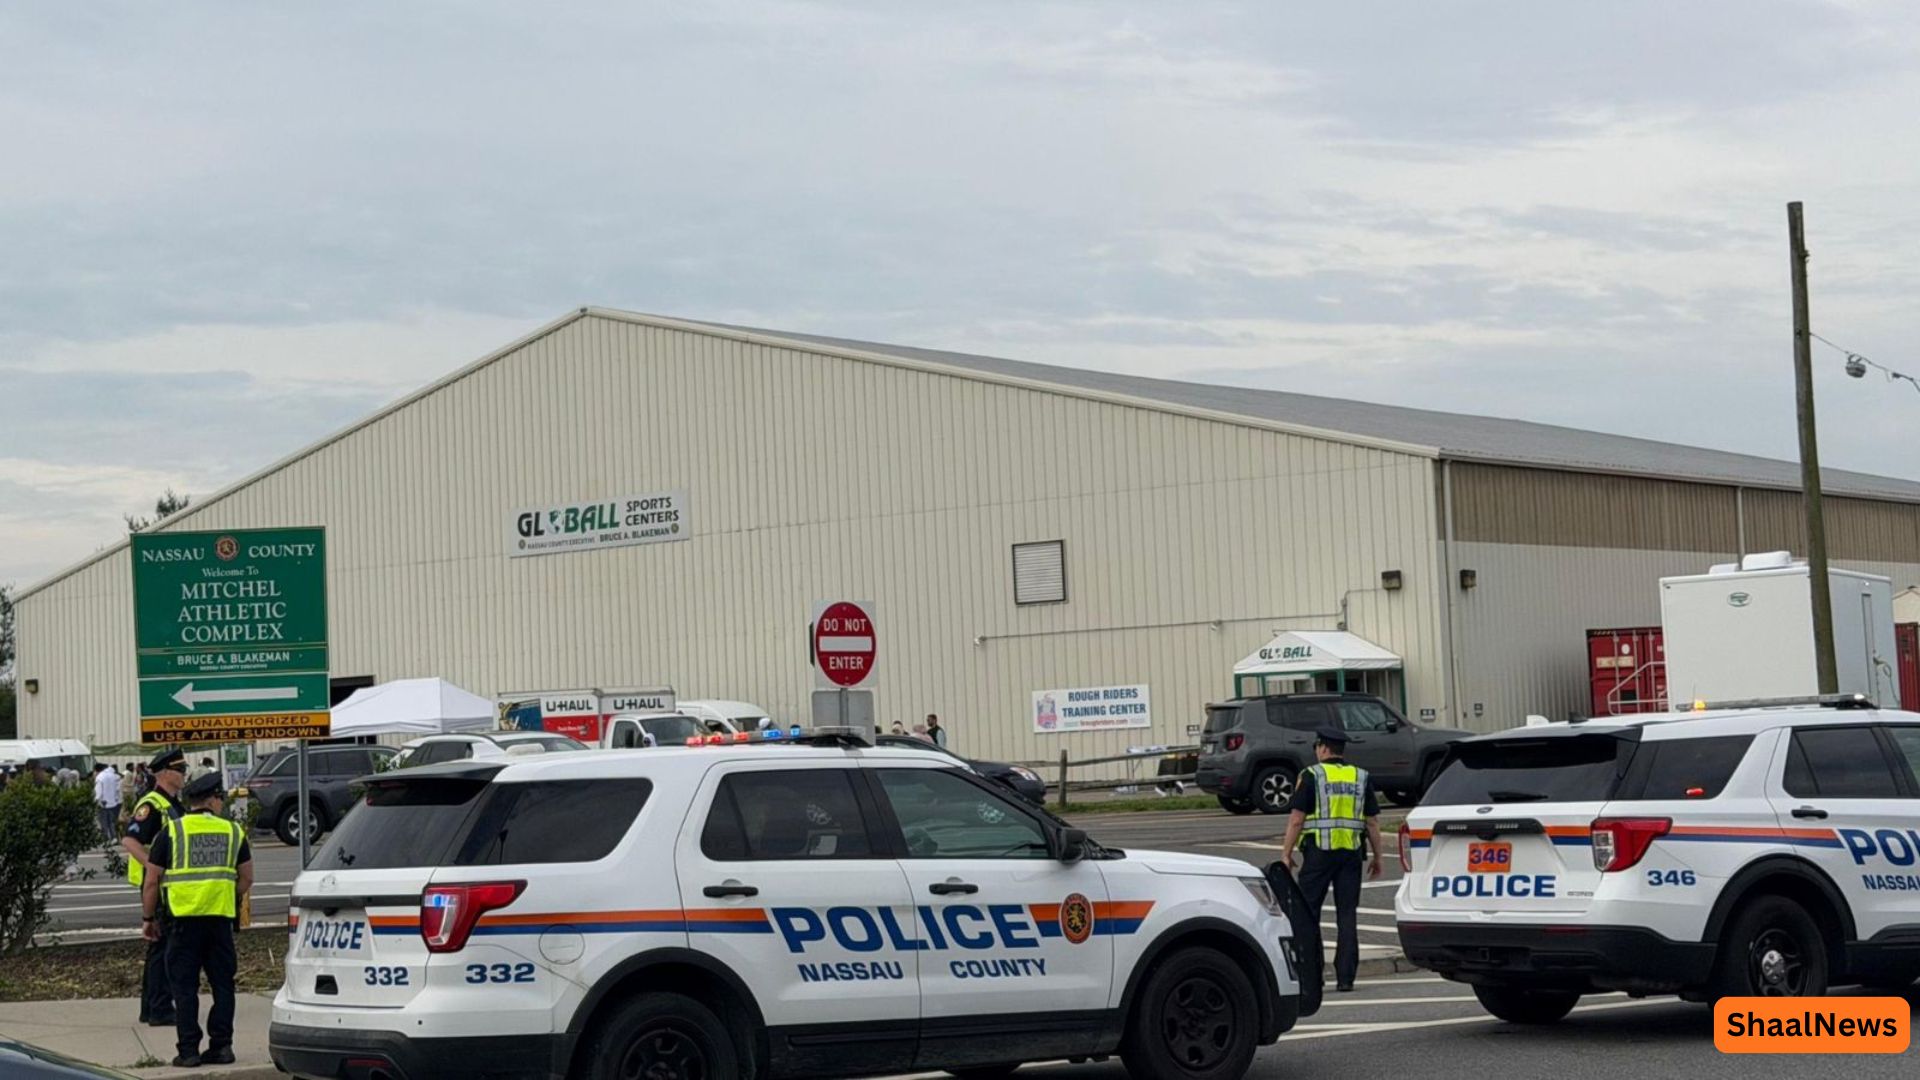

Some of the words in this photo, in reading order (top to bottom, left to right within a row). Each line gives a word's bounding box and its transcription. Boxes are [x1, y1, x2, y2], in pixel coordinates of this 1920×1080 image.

[626, 497, 672, 513] SPORTS
[625, 510, 679, 527] CENTERS
[600, 532, 622, 542] BRUCE
[632, 528, 670, 539] BLAKEMAN
[142, 548, 205, 562] NASSAU
[248, 544, 316, 558] COUNTY
[202, 567, 244, 577] Welcome
[247, 566, 259, 575] To
[181, 580, 282, 600] MITCHEL
[177, 602, 287, 622] ATHLETIC
[824, 618, 839, 631] DO
[845, 618, 867, 631] NOT
[181, 623, 284, 643] COMPLEX
[177, 653, 214, 665] BRUCE
[230, 652, 290, 664] BLAKEMAN
[829, 656, 864, 670] ENTER
[1068, 690, 1100, 702] ROUGH
[1103, 688, 1138, 700] RIDERS
[546, 699, 593, 712] U-HAUL
[613, 698, 665, 710] U-HAUL
[1062, 706, 1106, 718] TRAINING
[1109, 703, 1146, 715] CENTER
[163, 719, 185, 729] NO
[191, 715, 310, 728] UNAUTHORIZED
[153, 730, 185, 742] USE
[190, 729, 239, 740] AFTER
[244, 727, 320, 738] SUNDOWN
[1324, 783, 1361, 796] POLICE
[1470, 848, 1509, 864] 346
[1431, 874, 1557, 898] POLICE
[1647, 870, 1696, 887] 346
[304, 920, 365, 950] POLICE
[770, 903, 1040, 953] POLICE
[364, 965, 410, 986] 332
[464, 962, 536, 984] 332
[798, 960, 904, 982] NASSAU
[949, 958, 1047, 979] COUNTY
